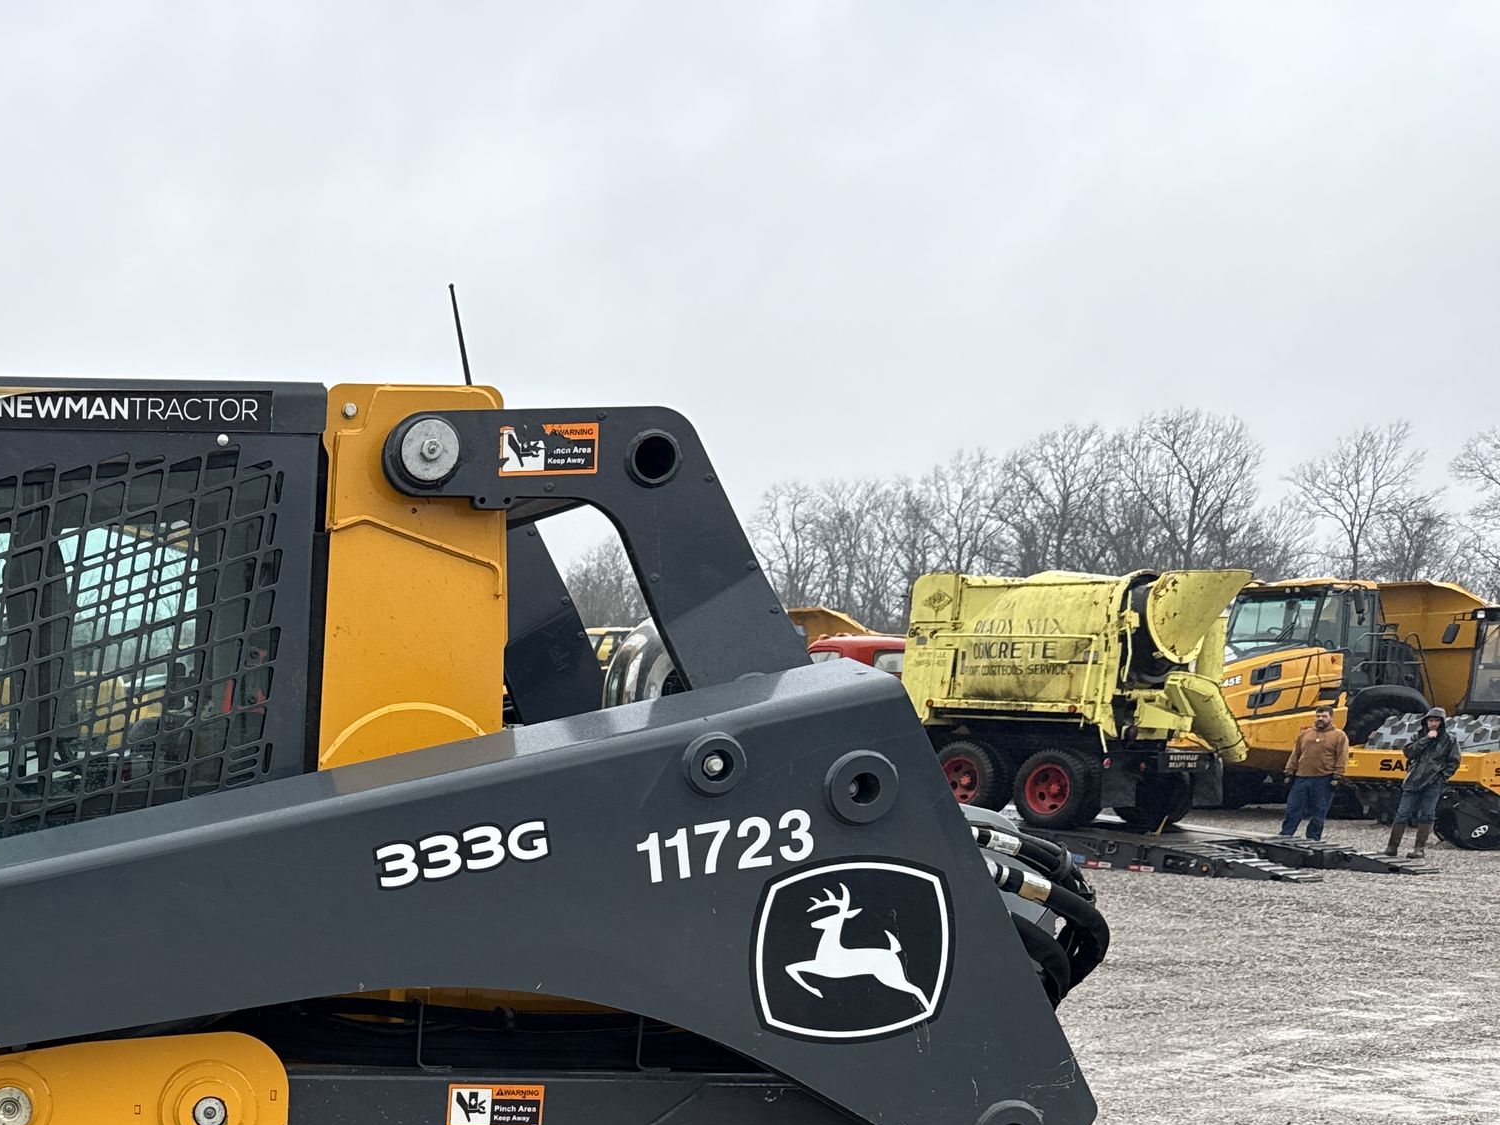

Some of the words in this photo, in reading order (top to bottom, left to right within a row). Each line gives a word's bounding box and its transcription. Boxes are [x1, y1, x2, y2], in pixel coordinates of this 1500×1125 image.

[572, 446, 592, 454] Area
[547, 457, 565, 466] Keep
[566, 457, 586, 465] Away
[973, 641, 1057, 660] CONCRETE
[1026, 663, 1067, 675] SERVICE
[1221, 675, 1242, 687] 45E
[1380, 759, 1409, 771] SA
[636, 809, 815, 883] 11723
[376, 821, 549, 887] 333G
[494, 1105, 517, 1113] Pinch
[517, 1105, 537, 1113] Area
[493, 1115, 511, 1123] Keep
[511, 1115, 531, 1123] Away
